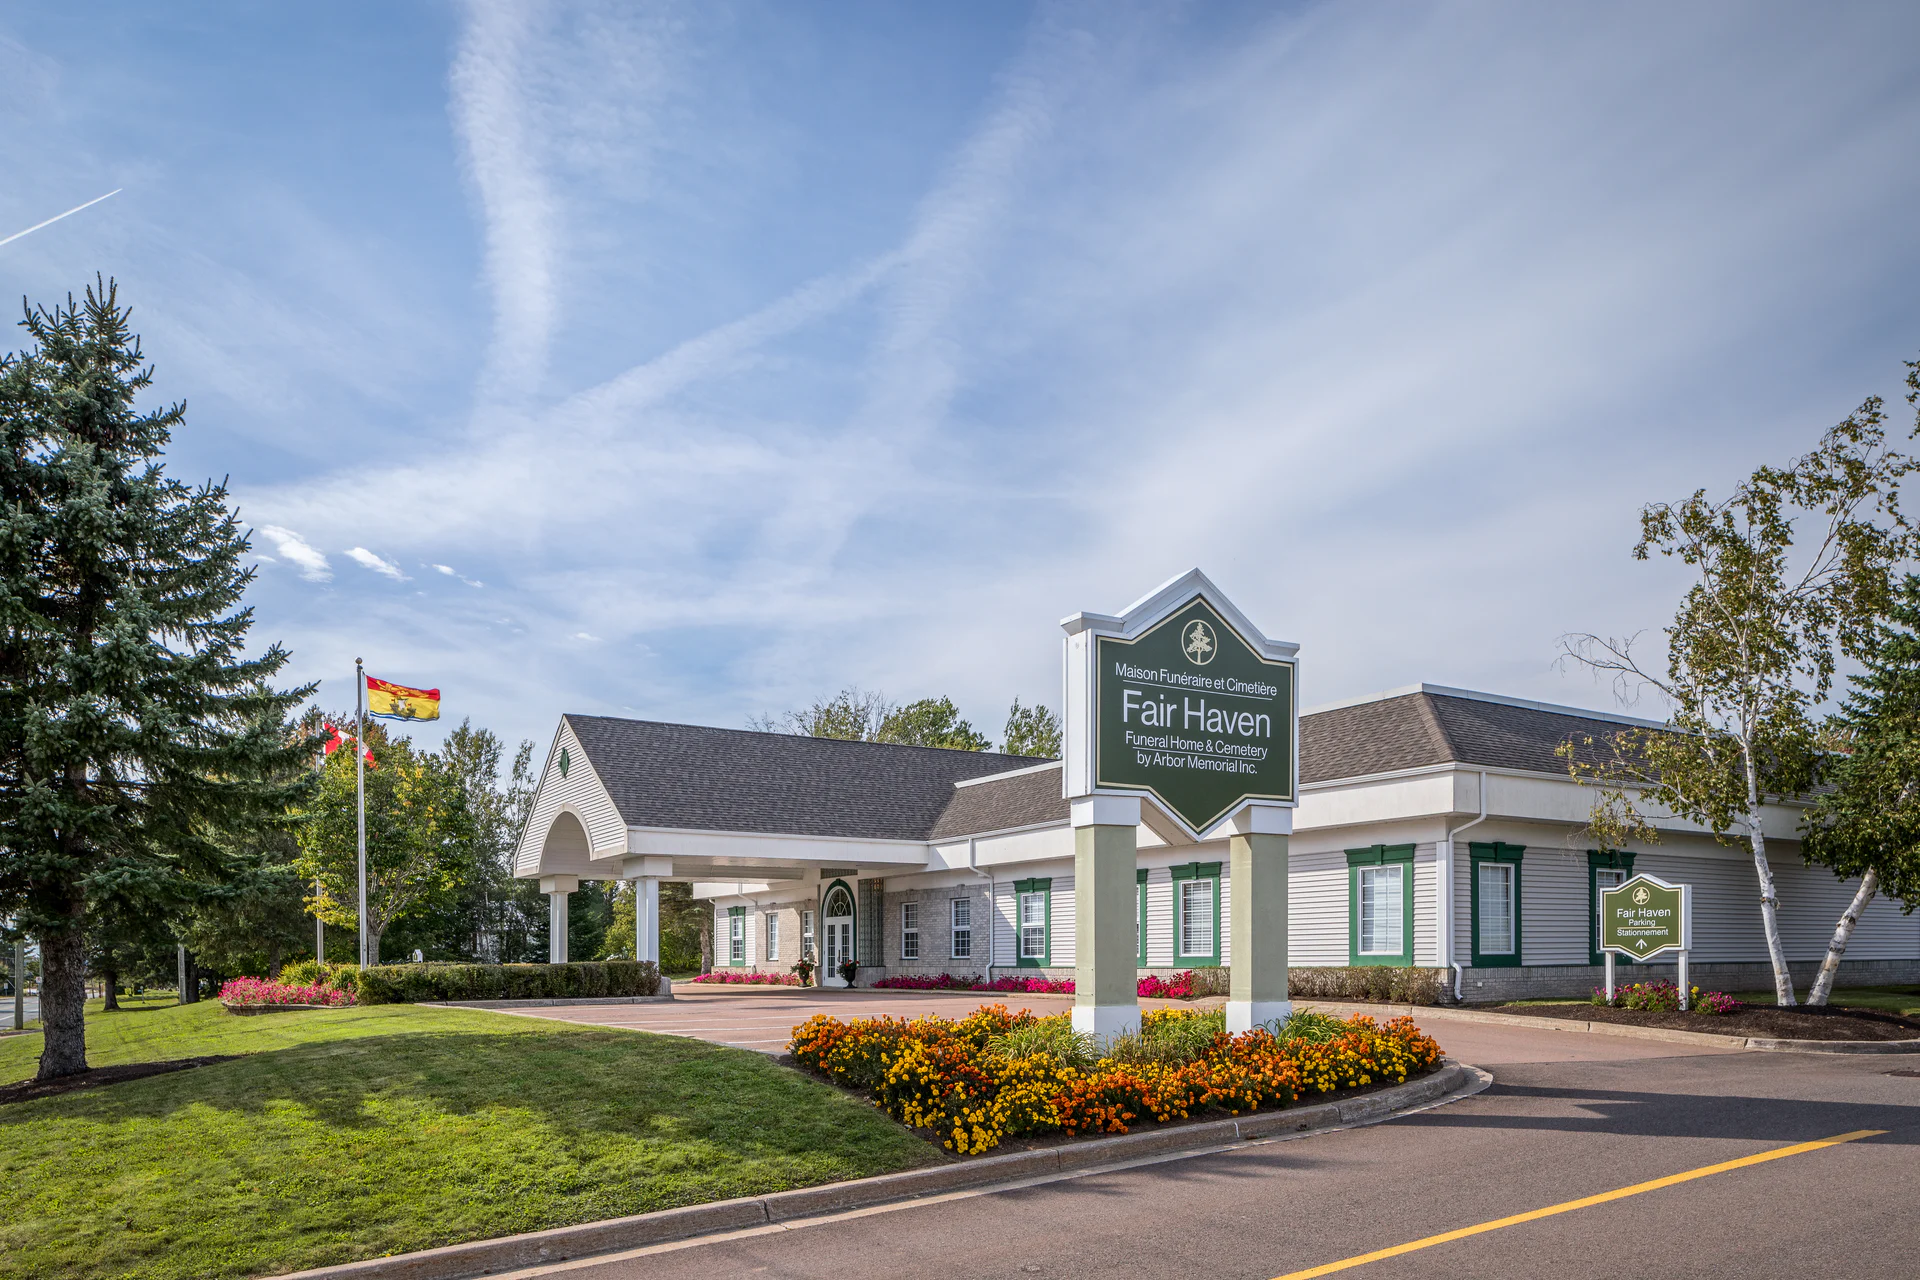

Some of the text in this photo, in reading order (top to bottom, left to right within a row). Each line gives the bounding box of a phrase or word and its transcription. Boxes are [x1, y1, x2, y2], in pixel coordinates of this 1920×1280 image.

[1115, 662, 1277, 696] Maison Funéraire et Cimetière
[1123, 689, 1271, 738] Fair Haven
[1125, 730, 1268, 760] Funeral Home & Cemetery
[1137, 750, 1258, 774] by Arbor Memorial Inc.
[1616, 907, 1671, 918] Fair Haven
[1628, 918, 1656, 928] Parking
[1616, 928, 1669, 937] Stationnement
